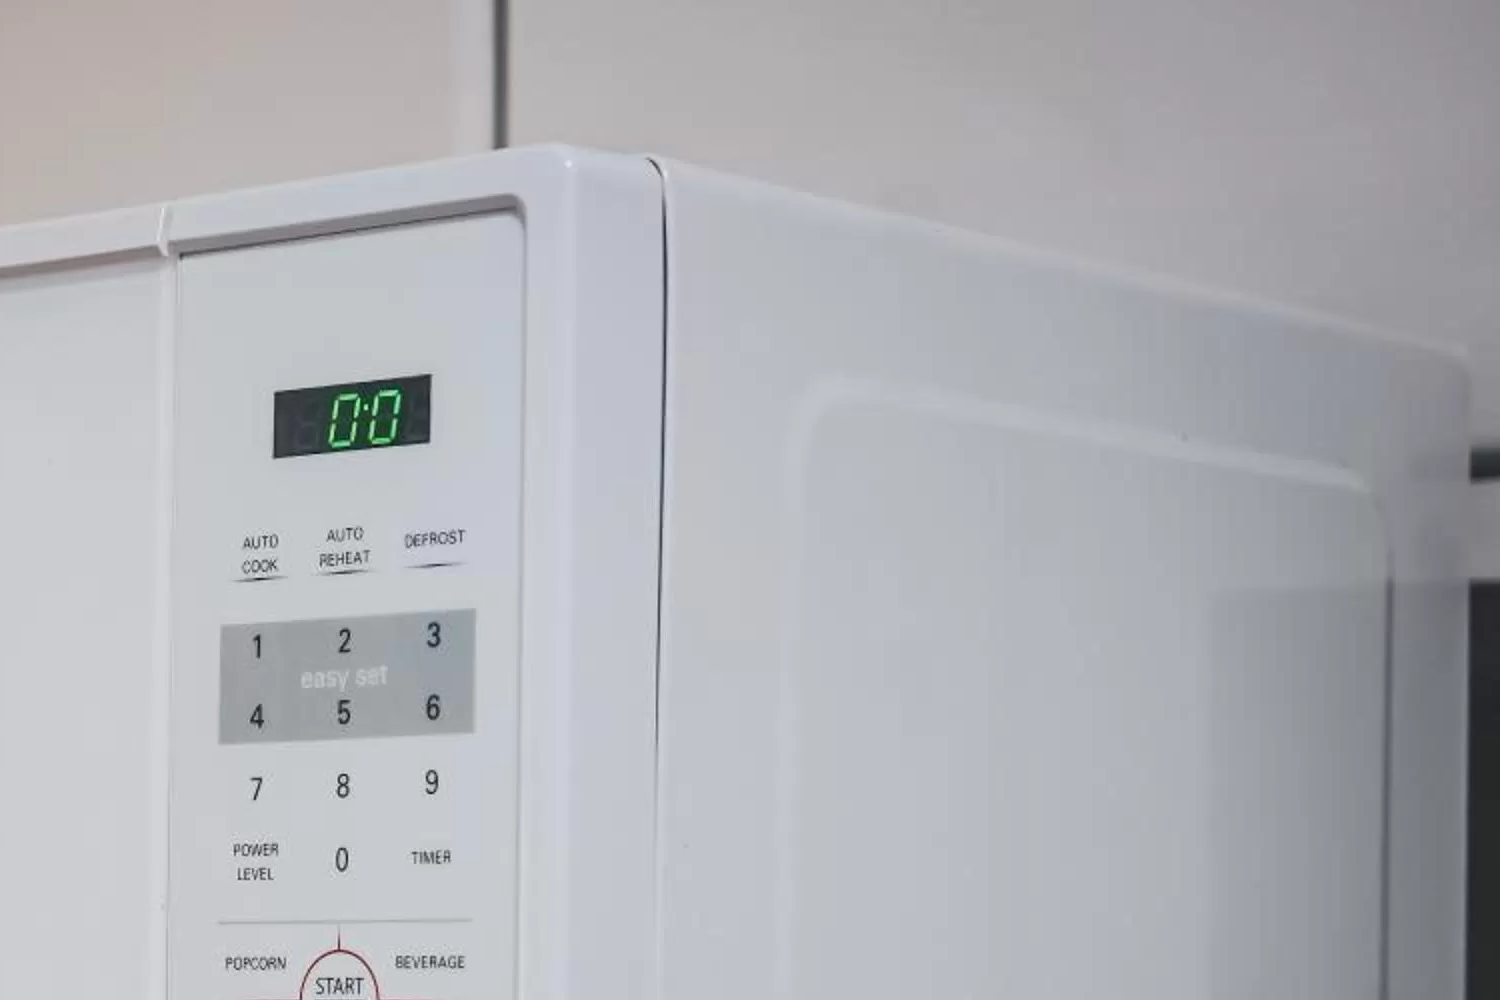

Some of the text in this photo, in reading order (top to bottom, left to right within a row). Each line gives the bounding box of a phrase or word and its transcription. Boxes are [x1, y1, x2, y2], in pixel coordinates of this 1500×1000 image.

[242, 533, 279, 550] AUTO
[326, 526, 364, 543] AUTO
[404, 529, 466, 549] DEFROST
[241, 558, 278, 575] COOK
[319, 550, 371, 568] REHEAT
[337, 627, 352, 654] 2
[426, 621, 441, 648] 3
[252, 633, 261, 659] 1
[300, 664, 388, 693] easy set
[249, 703, 264, 729] 4
[337, 699, 351, 725] 5
[425, 694, 441, 721] 6
[250, 777, 263, 801] 7
[336, 772, 350, 799] 8
[425, 769, 439, 795] 9
[233, 843, 279, 857] POWER
[335, 847, 349, 873] 0
[411, 850, 451, 865] TIMER
[237, 867, 275, 881] LEVEL
[225, 956, 287, 971] POPCORN
[395, 955, 465, 970] BEVERAGE
[315, 977, 364, 995] START
